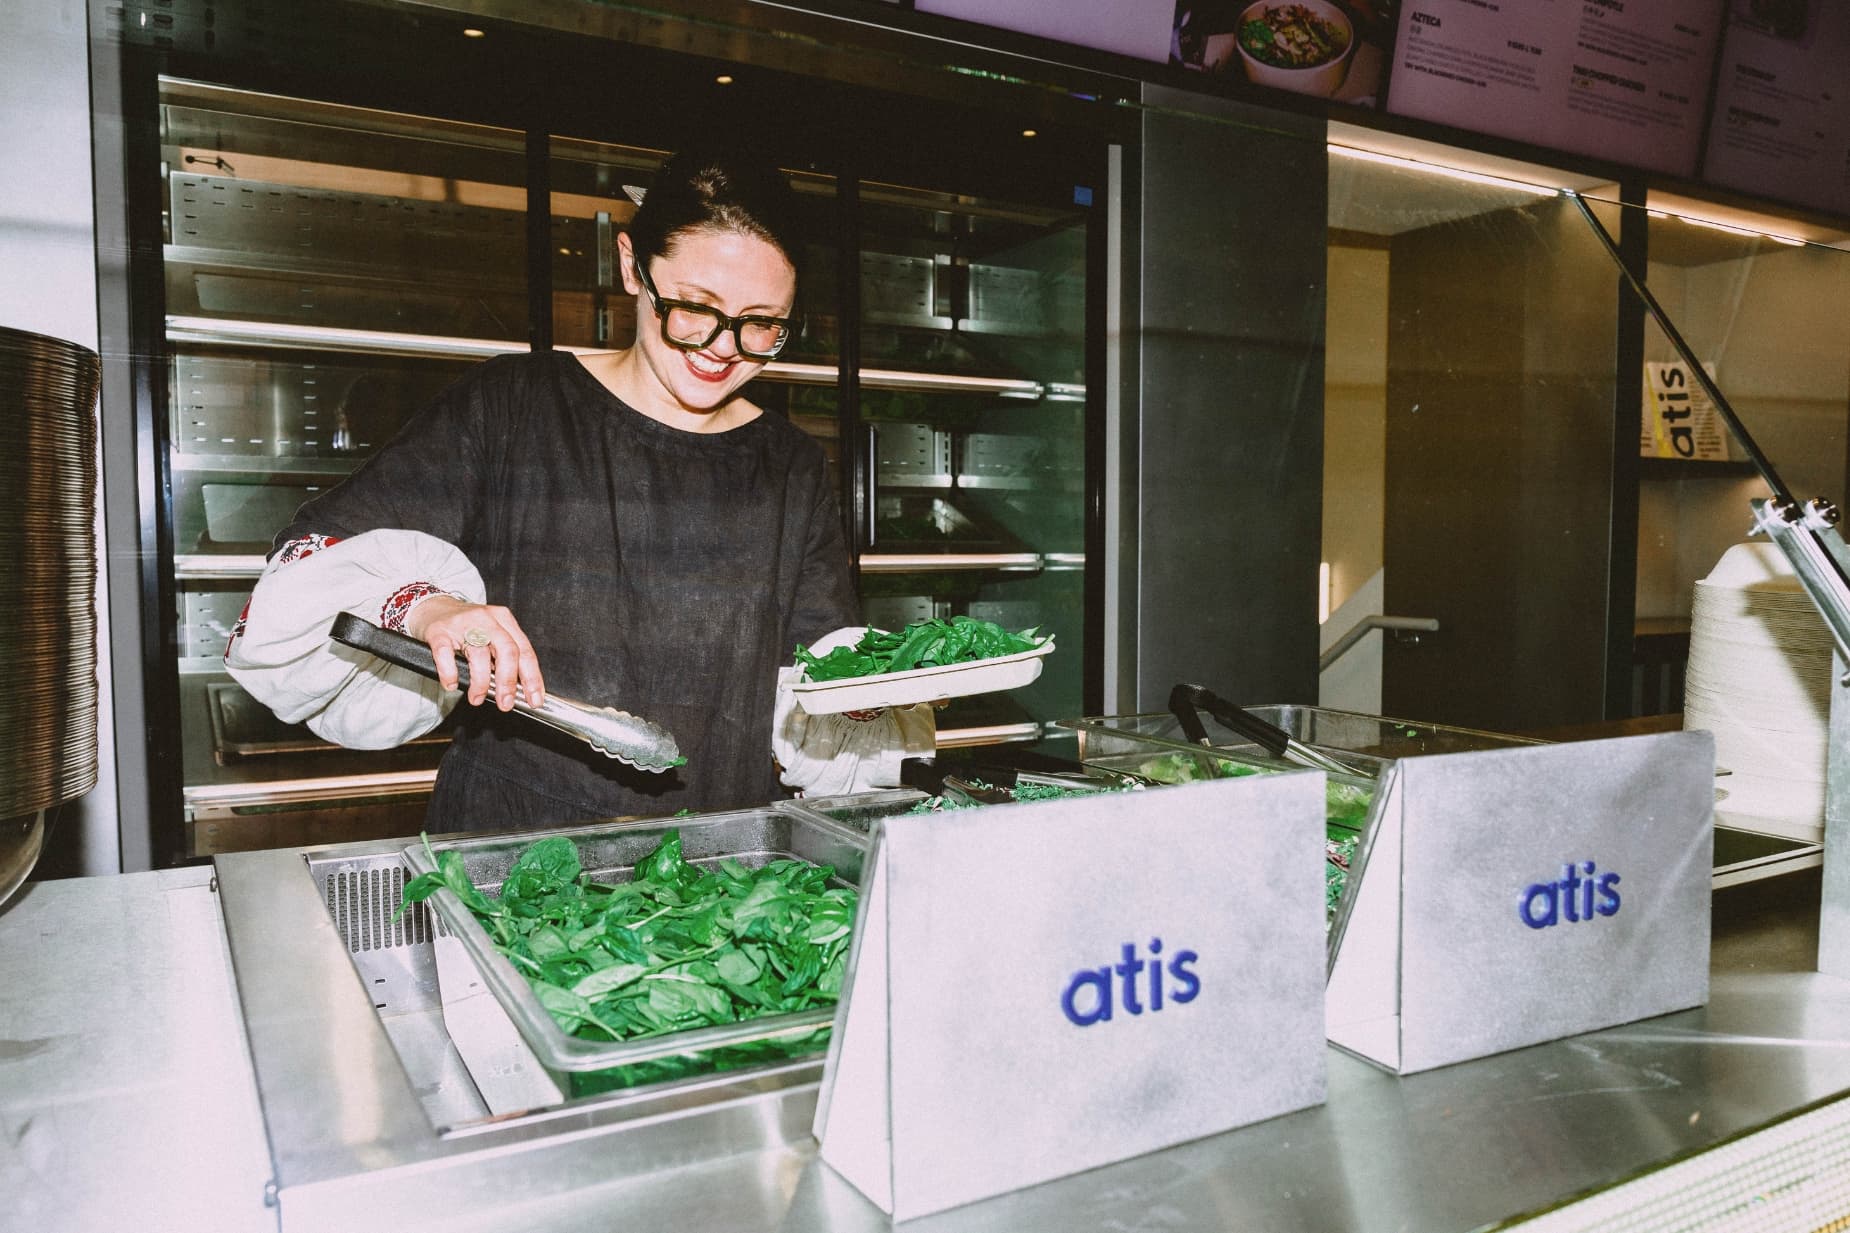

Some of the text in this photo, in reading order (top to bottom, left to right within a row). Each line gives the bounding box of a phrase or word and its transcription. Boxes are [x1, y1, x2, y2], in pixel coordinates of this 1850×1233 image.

[1410, 11, 1441, 28] AZTECA
[1658, 368, 1695, 457] atis
[1519, 861, 1621, 930] atis
[1061, 937, 1201, 1027] atis
